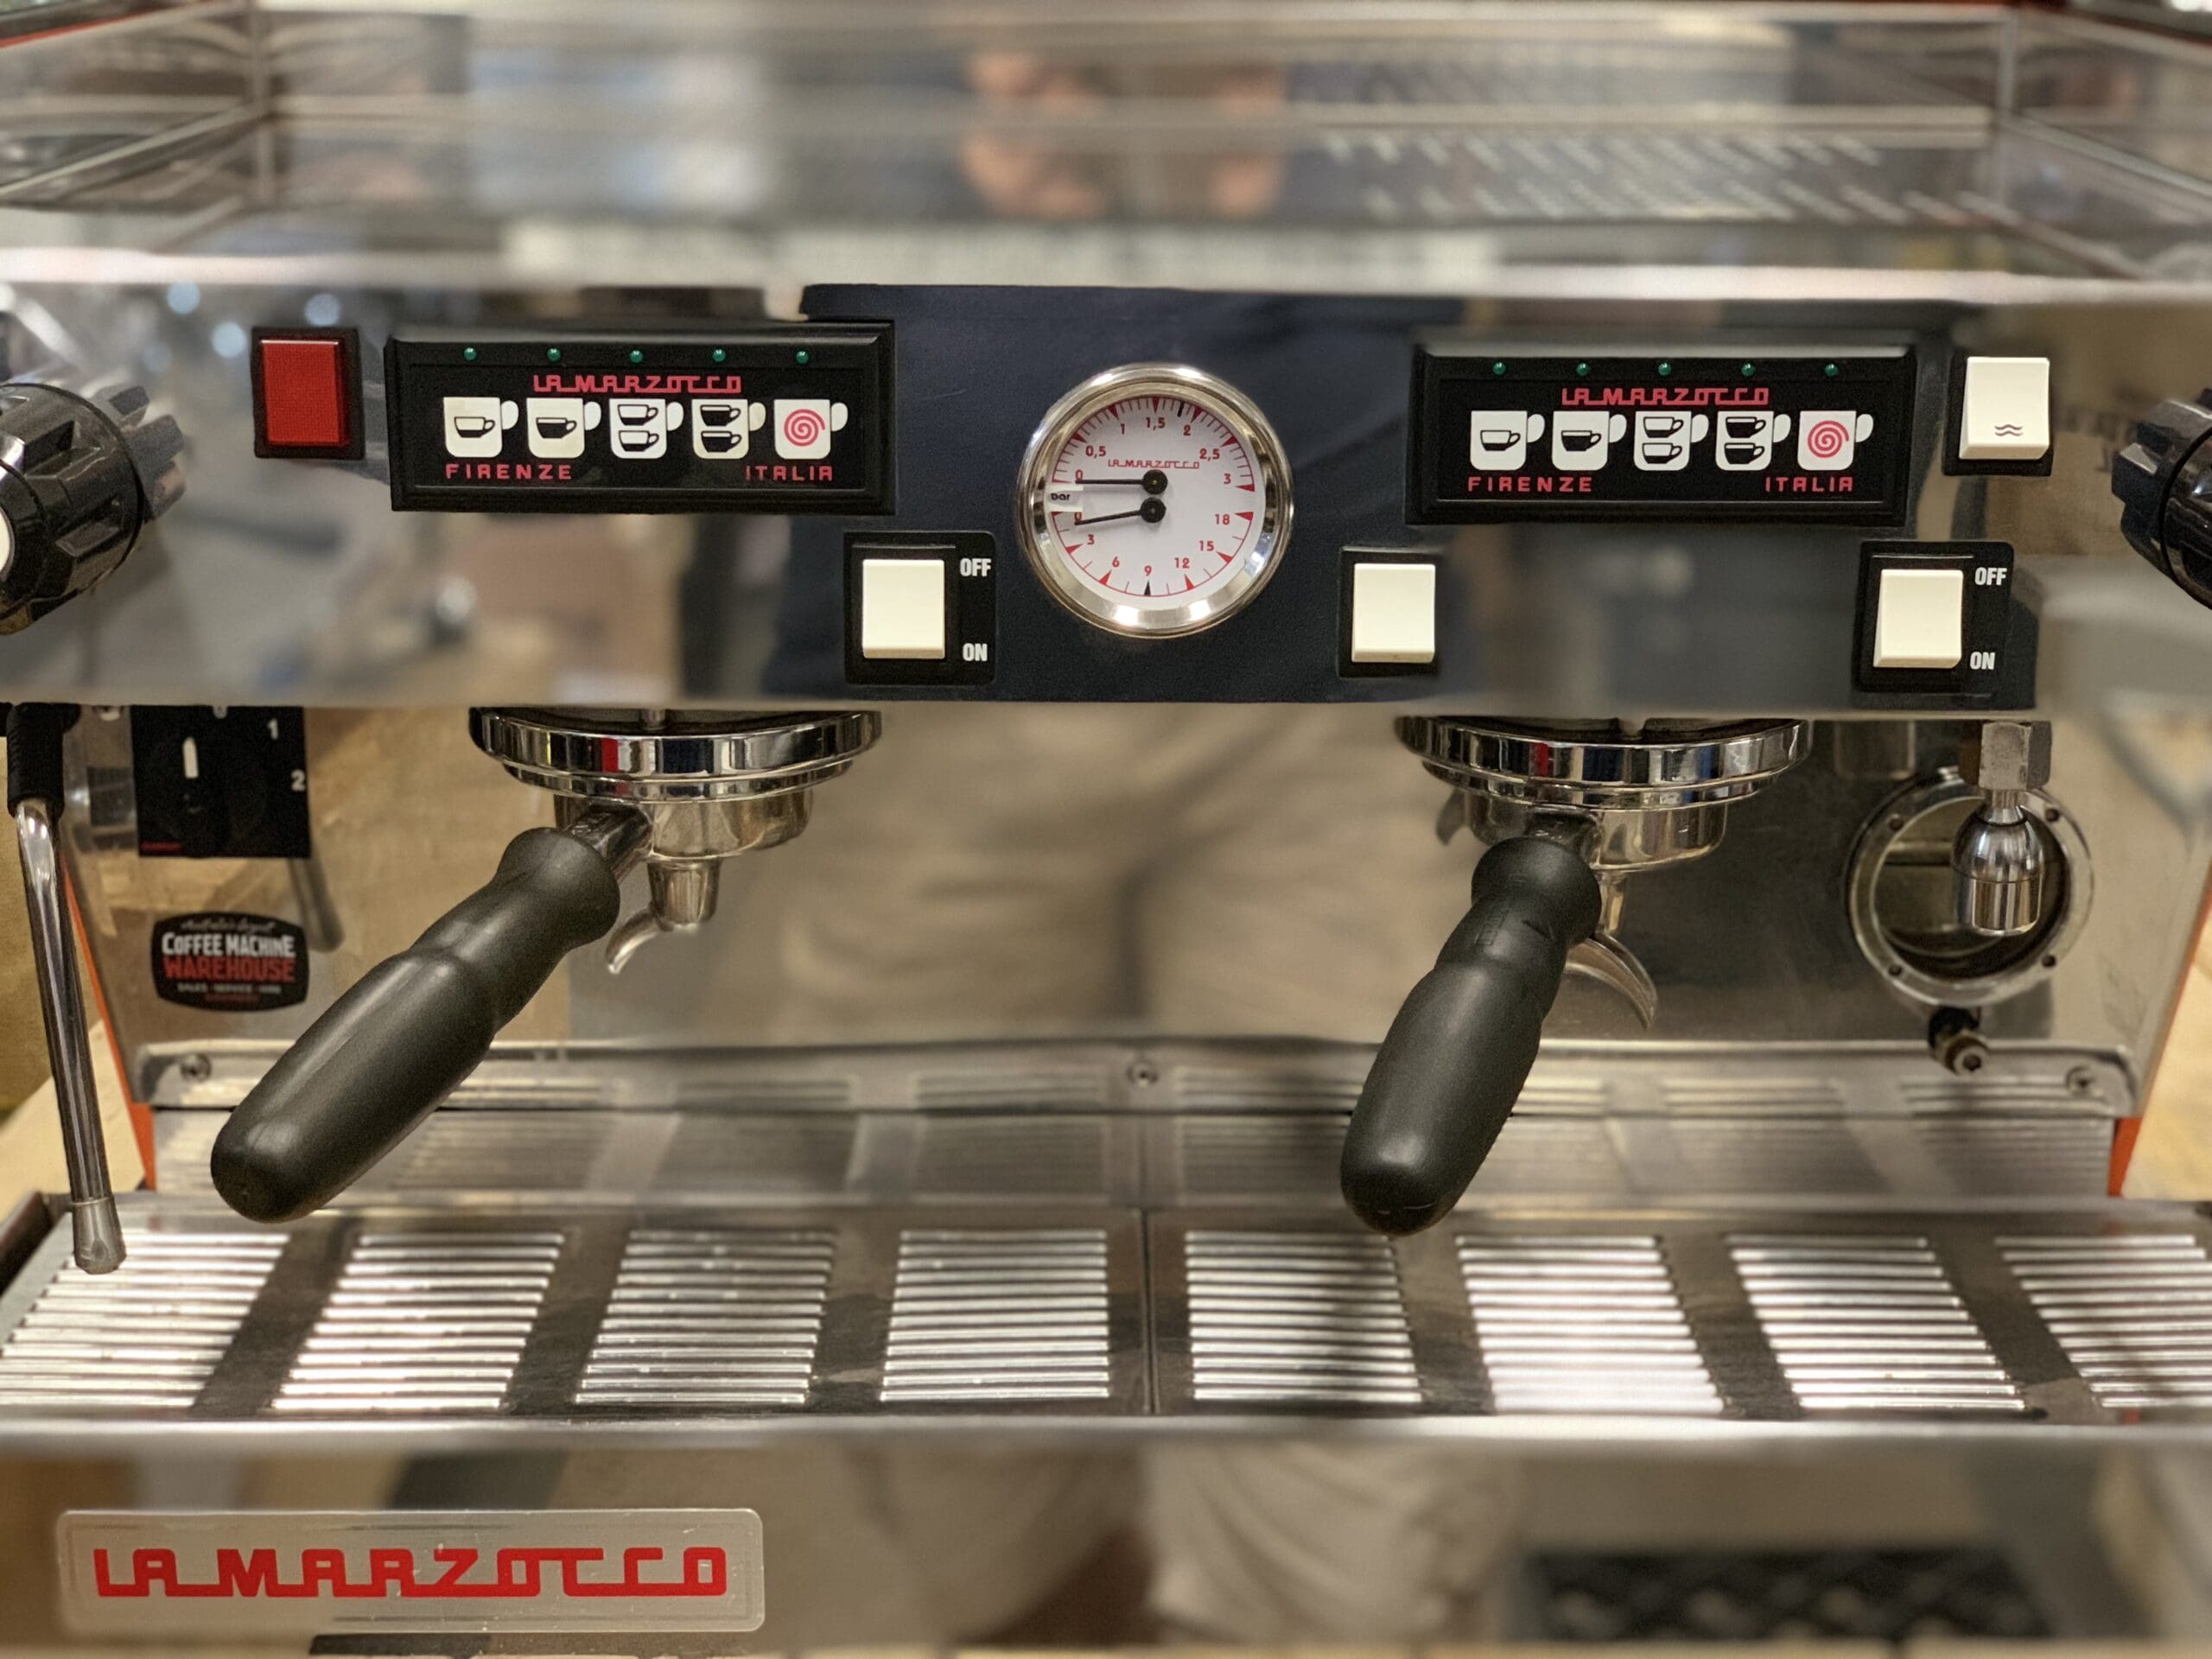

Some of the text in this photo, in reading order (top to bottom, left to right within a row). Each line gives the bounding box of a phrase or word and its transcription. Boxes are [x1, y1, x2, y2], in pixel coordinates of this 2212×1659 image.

[533, 374, 742, 394] LA MARZOCCO
[1562, 387, 1770, 406] LA MARZOCCO
[1120, 423, 1125, 434] 1
[1183, 424, 1192, 436] 2
[445, 463, 571, 480] FIRENZE
[746, 465, 833, 481] ITALIA
[1224, 473, 1232, 486] 3
[1468, 476, 1592, 493] FIRENZE
[1764, 476, 1854, 493] ITALIA
[1050, 493, 1071, 501] bar
[1215, 513, 1230, 526] 18
[1087, 533, 1095, 545] 3
[1198, 539, 1215, 552] 15
[960, 558, 992, 577] OFF
[1112, 556, 1120, 568] 6
[1144, 565, 1152, 576] 9
[1174, 557, 1190, 569] 12
[1974, 567, 2008, 586] OFF
[963, 643, 988, 662] ON
[1969, 652, 1996, 671] ON
[267, 718, 279, 740] 1
[291, 770, 306, 791] 2
[162, 932, 296, 958] COFFEE MACHINE
[163, 955, 296, 983] WAREHOUSE
[92, 1547, 728, 1598] LA MARZOCCO
